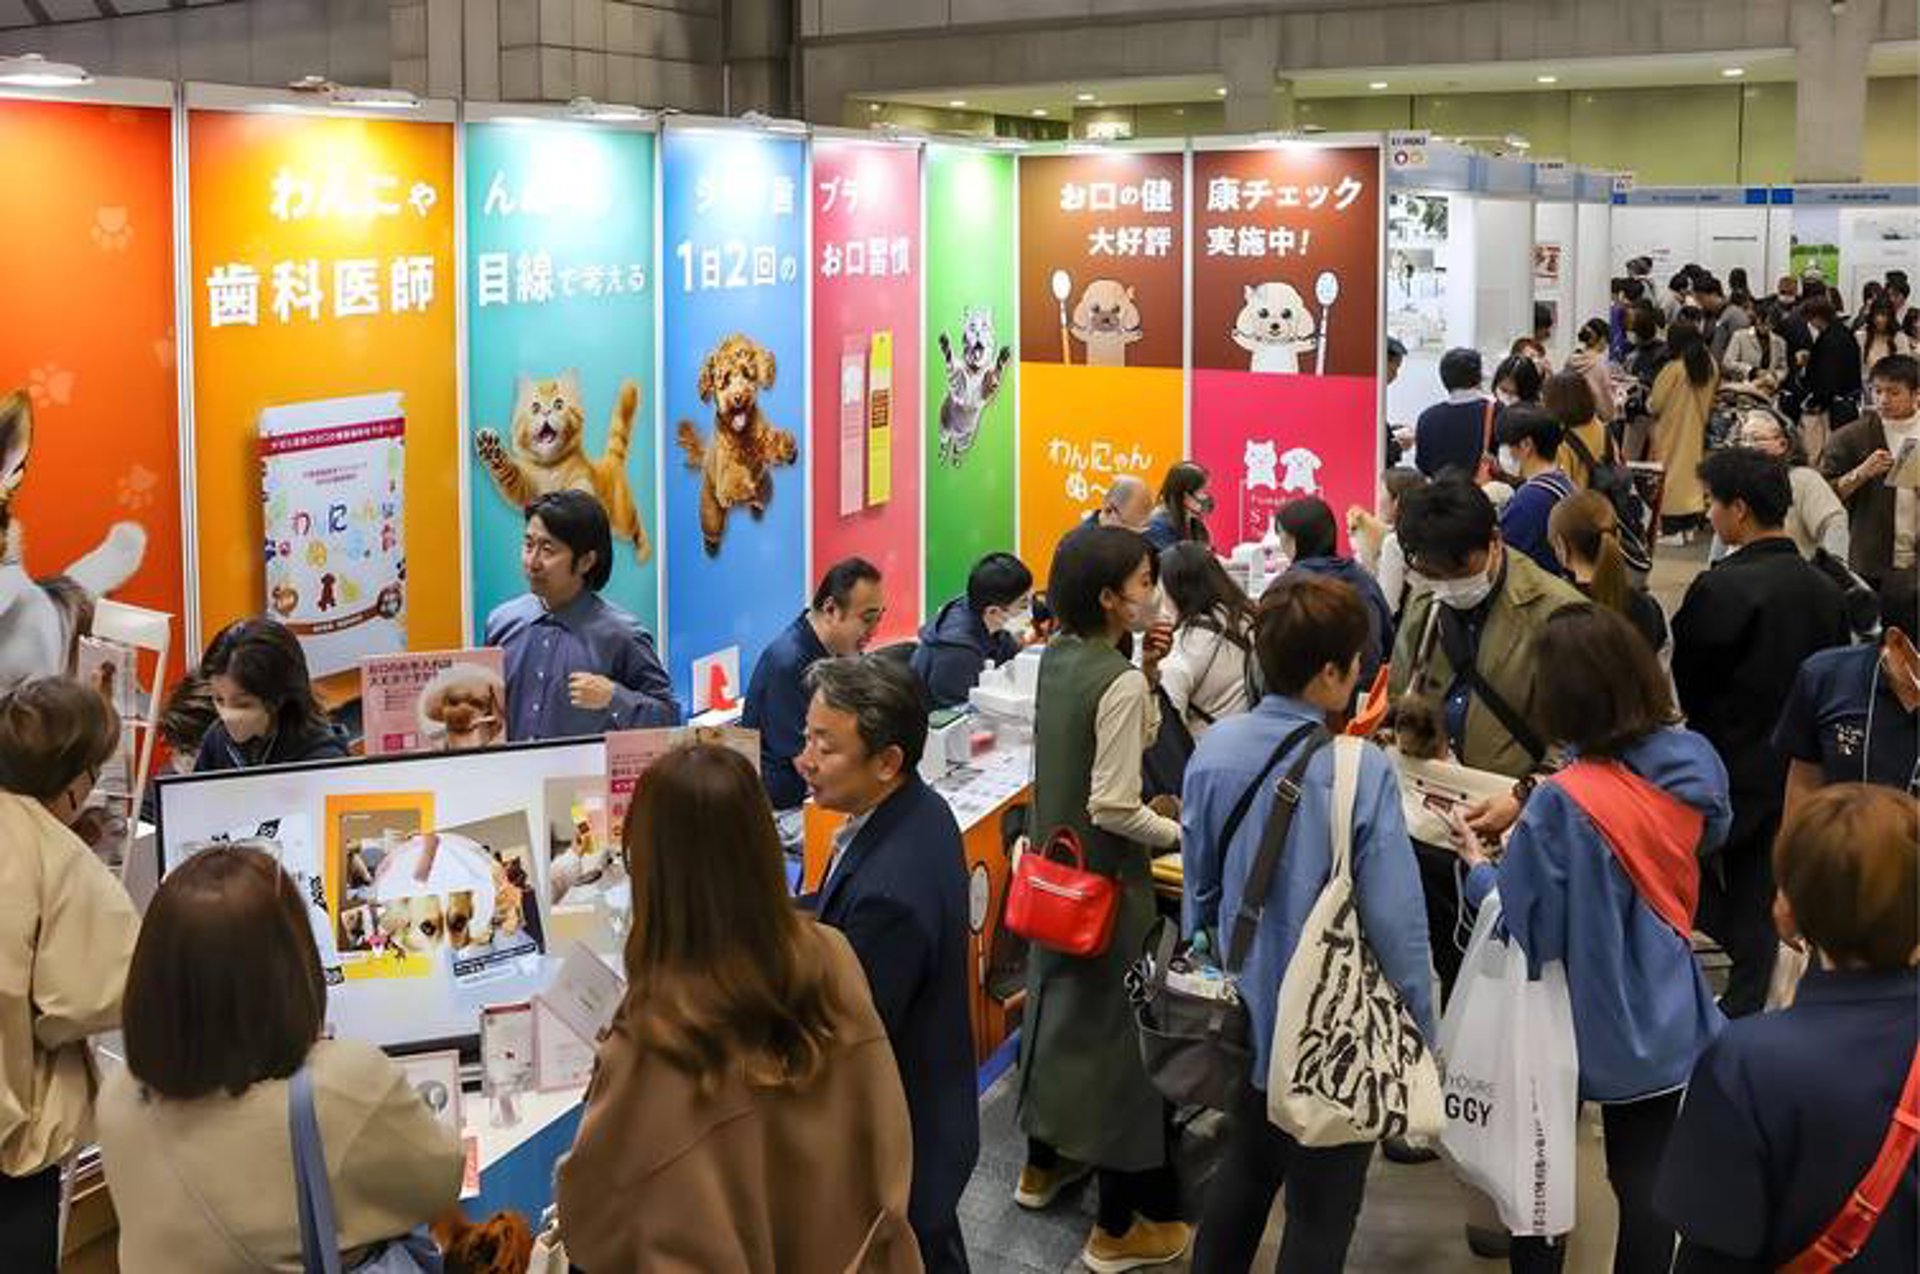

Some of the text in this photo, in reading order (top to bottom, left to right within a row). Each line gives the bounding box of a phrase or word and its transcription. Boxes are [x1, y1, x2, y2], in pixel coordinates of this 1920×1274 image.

[1061, 178, 1172, 212] お口の健
[1207, 177, 1362, 210] 康チェック
[822, 237, 910, 279] お口習慣
[1089, 227, 1171, 257] 大好評
[478, 252, 645, 306] 目線で考える
[677, 240, 796, 293] 1日2回の
[207, 256, 435, 326] 歯科医師
[1048, 438, 1153, 471] わんにゃん
[1444, 1093, 1493, 1127] GGY
